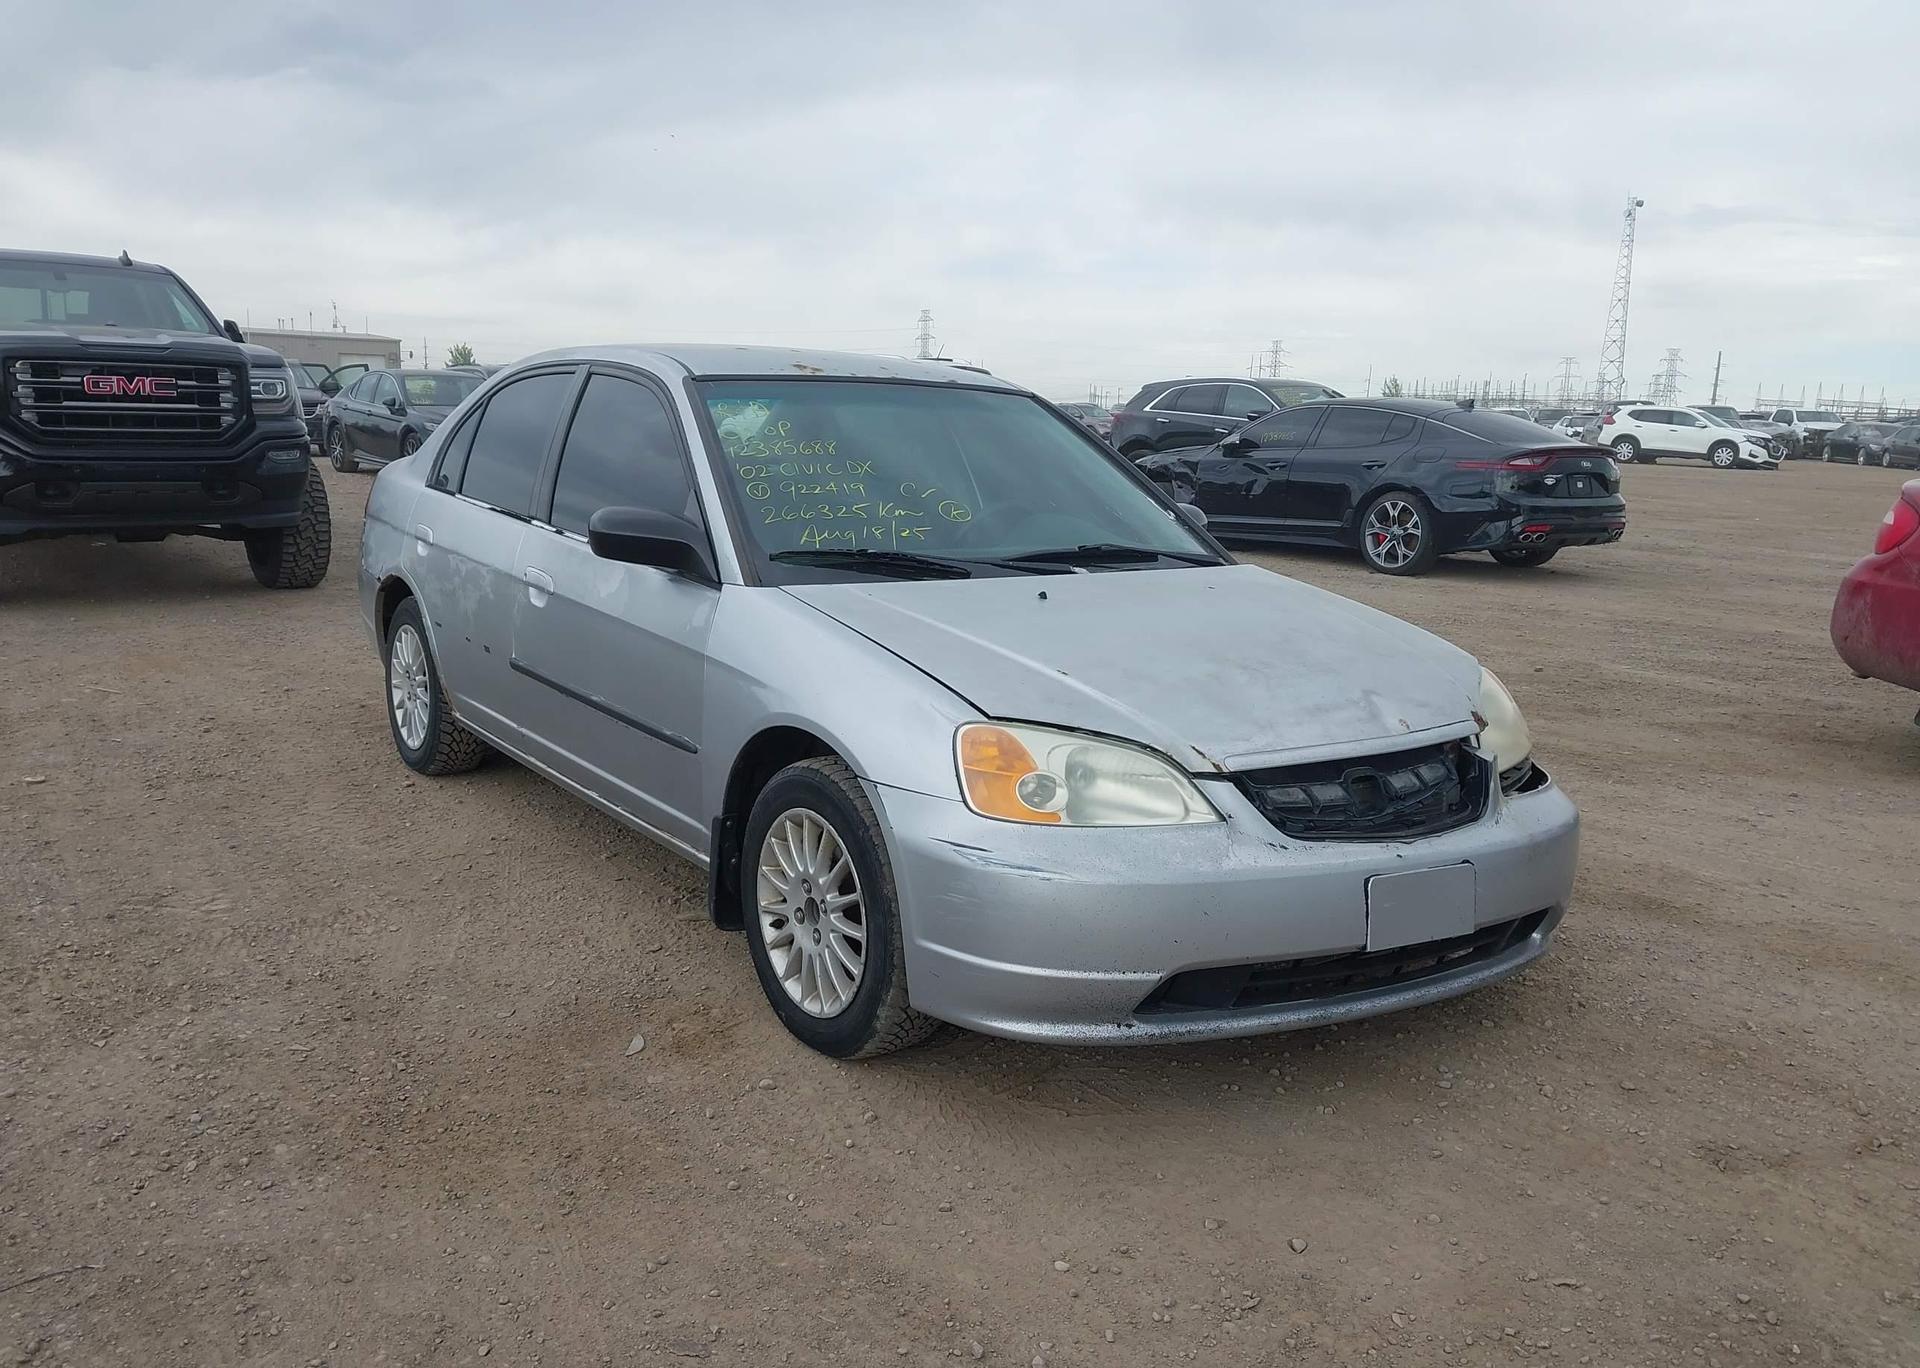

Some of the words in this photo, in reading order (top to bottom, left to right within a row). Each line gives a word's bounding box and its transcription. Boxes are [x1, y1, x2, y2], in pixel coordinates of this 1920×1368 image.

[82, 375, 177, 396] GMC
[779, 462, 843, 477] CIVIC
[847, 460, 876, 478] DX
[780, 480, 866, 501] 922419
[760, 503, 871, 524] 266325
[800, 524, 856, 549] Aug
